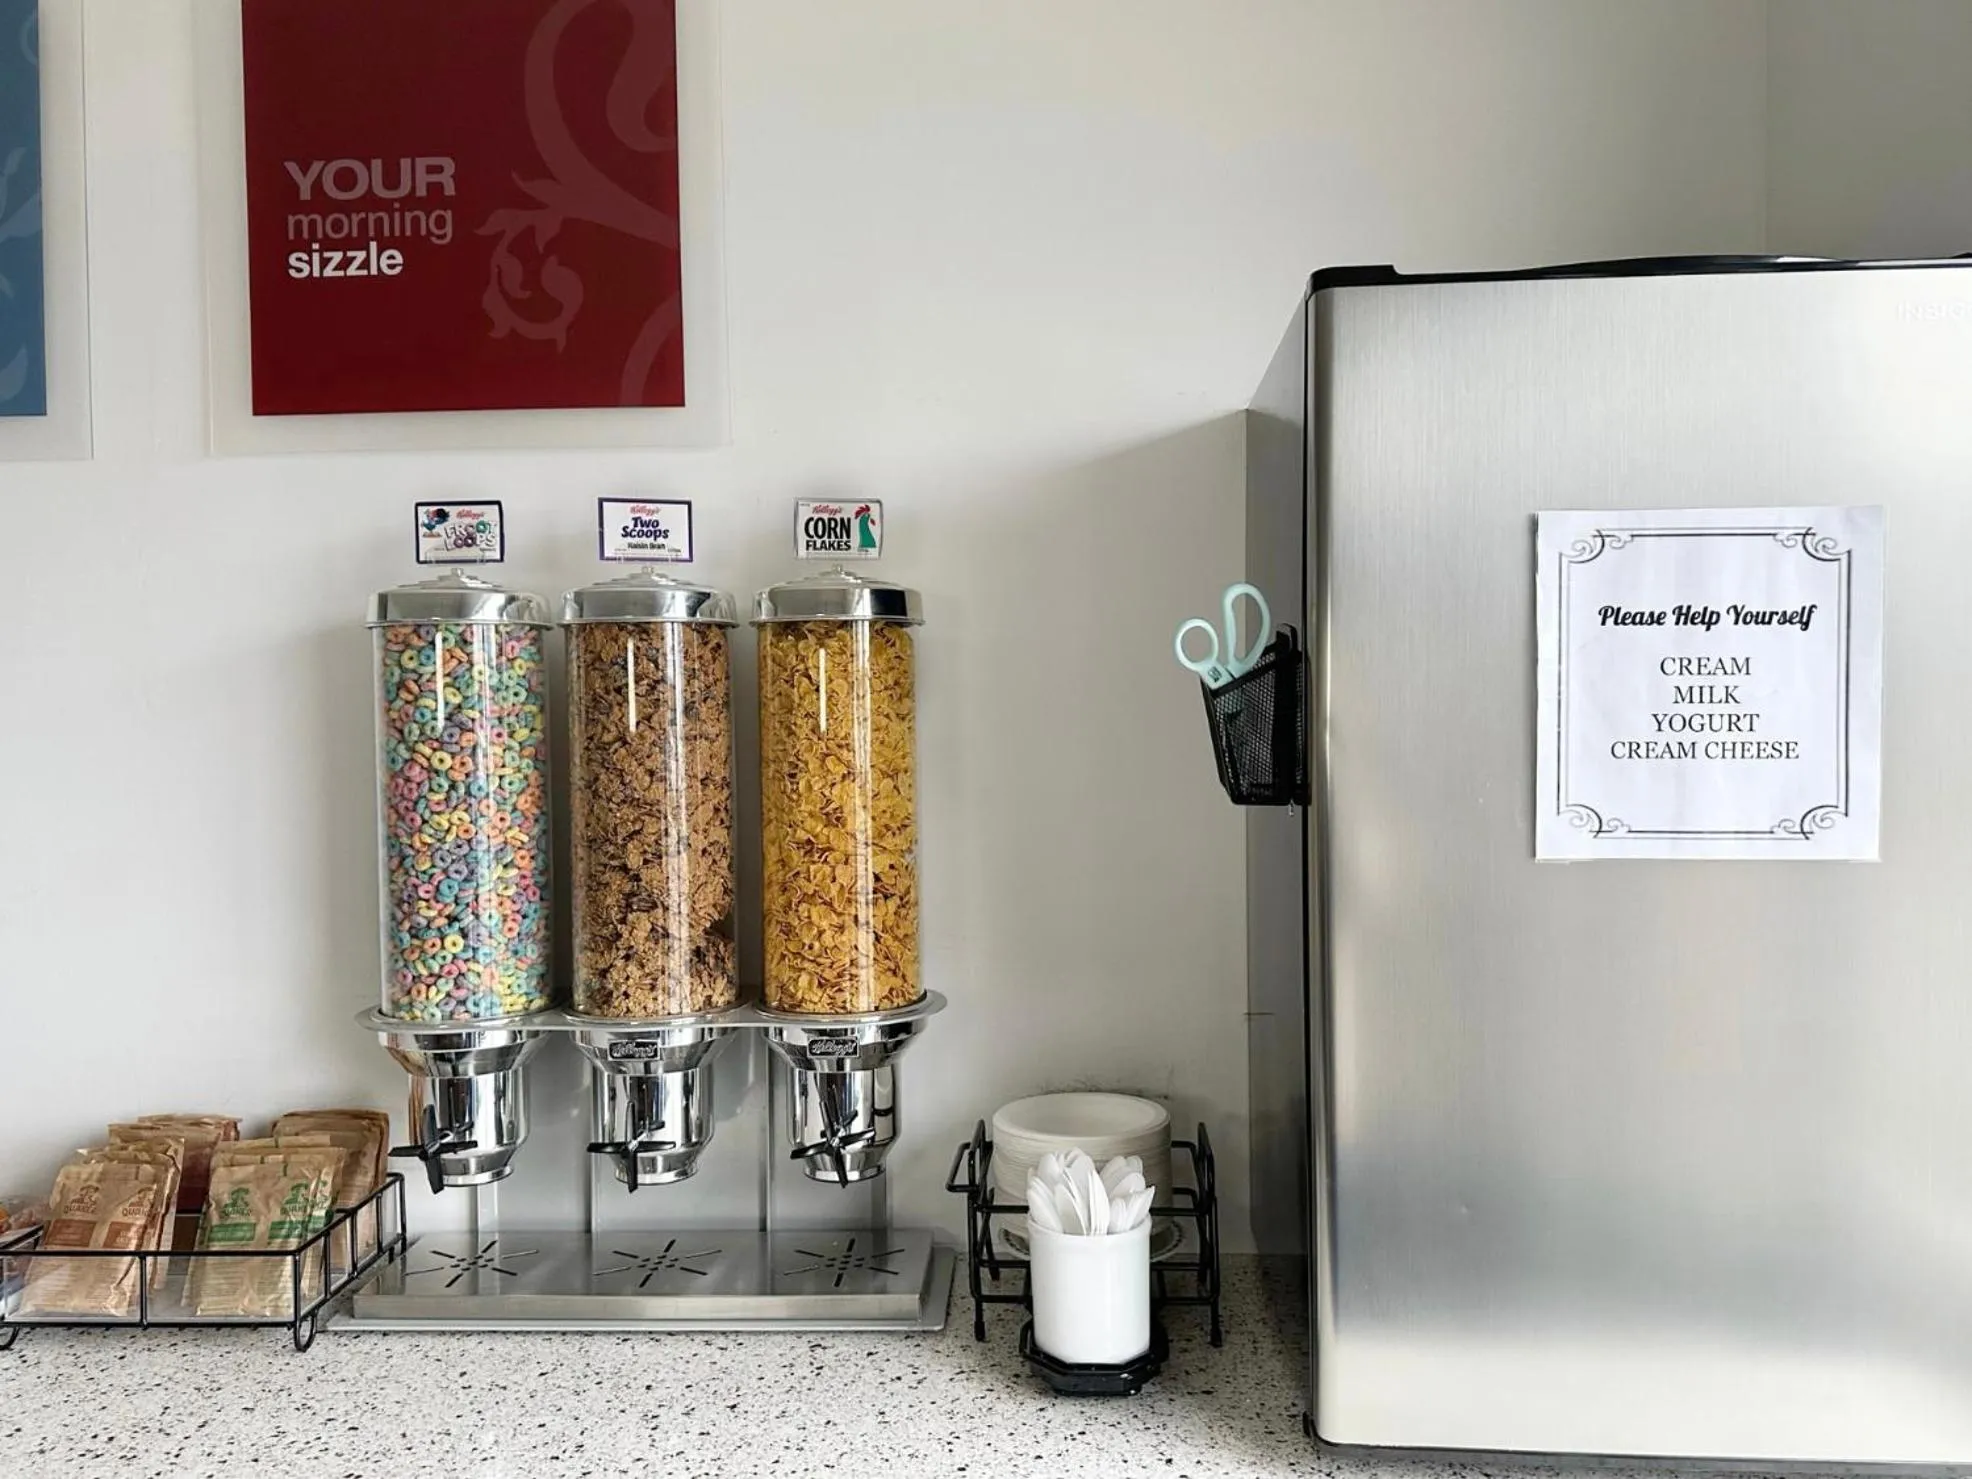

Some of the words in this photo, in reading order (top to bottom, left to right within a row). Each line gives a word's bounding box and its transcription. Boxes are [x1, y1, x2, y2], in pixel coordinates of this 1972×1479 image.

[283, 156, 457, 201] YOUR
[287, 202, 454, 245] morning
[287, 240, 404, 279] sizzle
[444, 520, 496, 539] FROOT
[631, 516, 660, 529] Two
[804, 516, 852, 540] CORN
[444, 533, 496, 552] LOOPS
[621, 525, 670, 542] Scoops
[805, 540, 852, 552] FLAKES
[1598, 605, 1667, 626] Please
[1672, 604, 1721, 632] Help
[1726, 604, 1818, 632] Yourself
[1660, 656, 1752, 676] CREAM
[1672, 685, 1741, 704] MILK
[1651, 713, 1760, 733] YOGURT
[1610, 741, 1696, 760] CREAM
[1704, 741, 1800, 760] CHEESE
